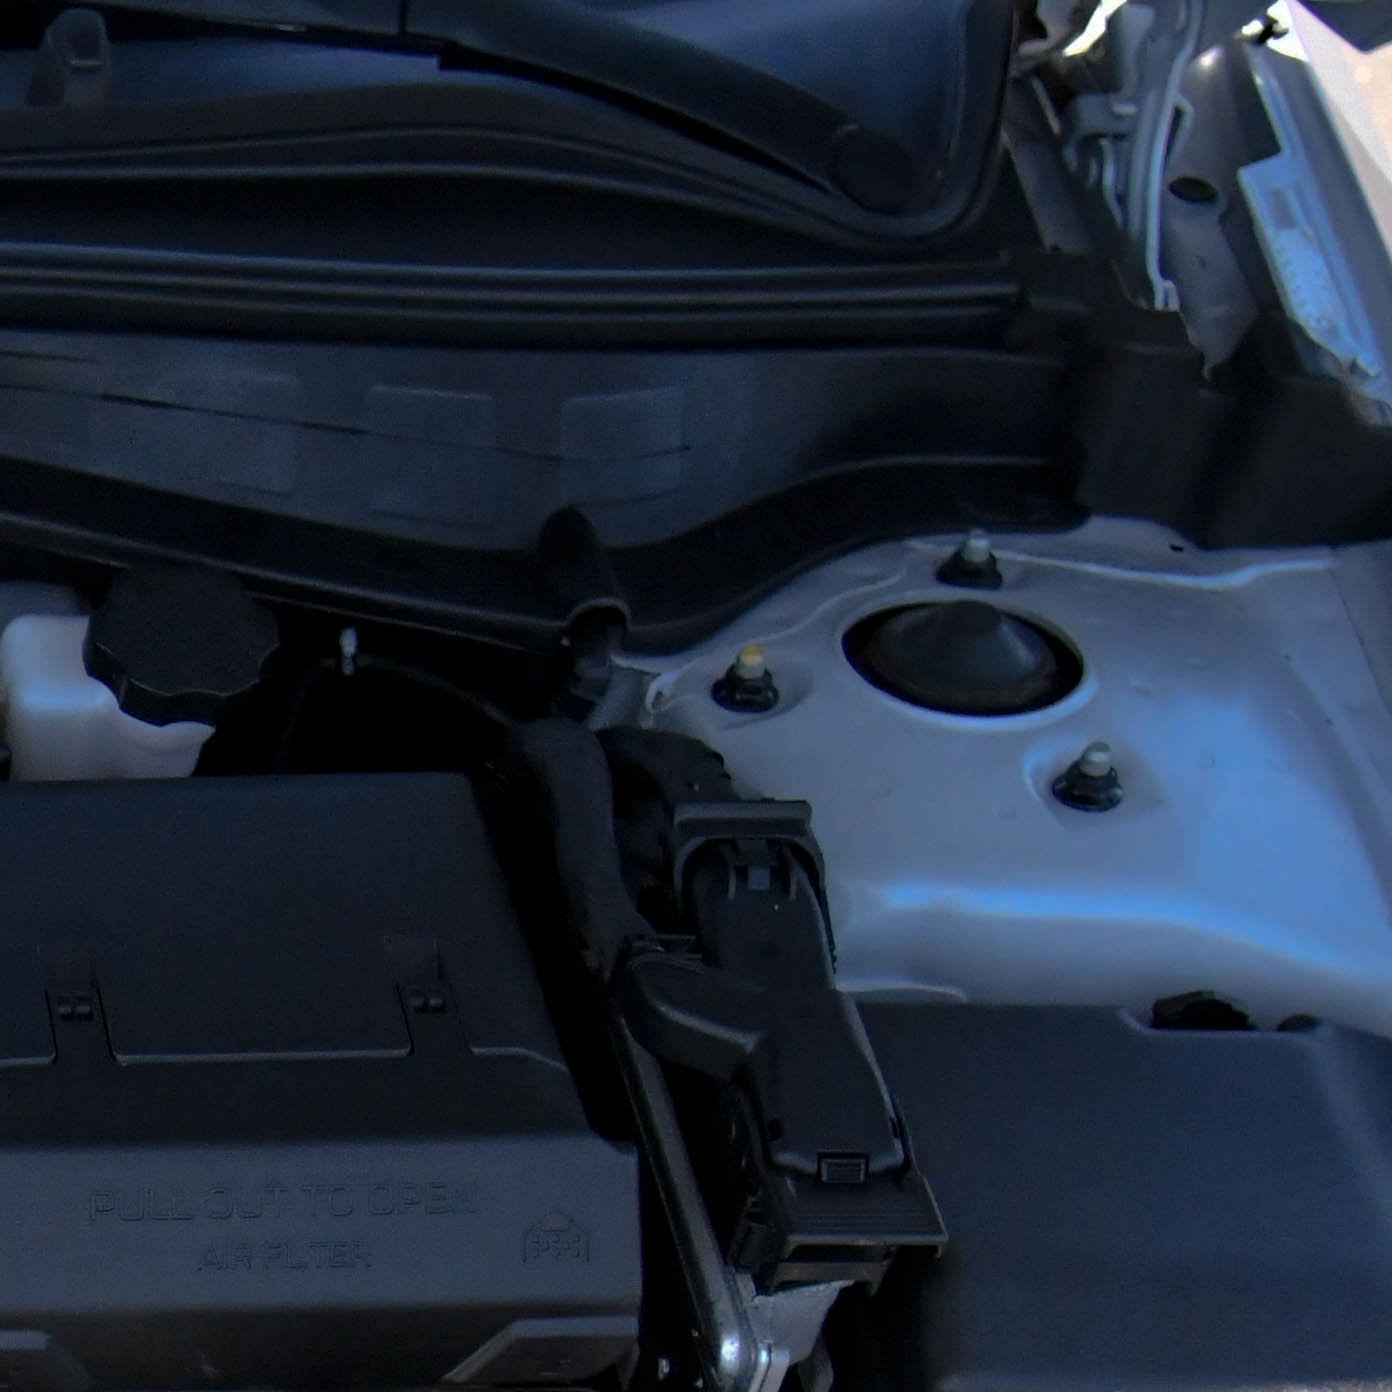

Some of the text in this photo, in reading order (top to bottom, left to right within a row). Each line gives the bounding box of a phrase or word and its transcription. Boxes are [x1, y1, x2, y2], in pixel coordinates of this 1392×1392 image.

[88, 1181, 480, 1223] PULL OUT TO OPEN
